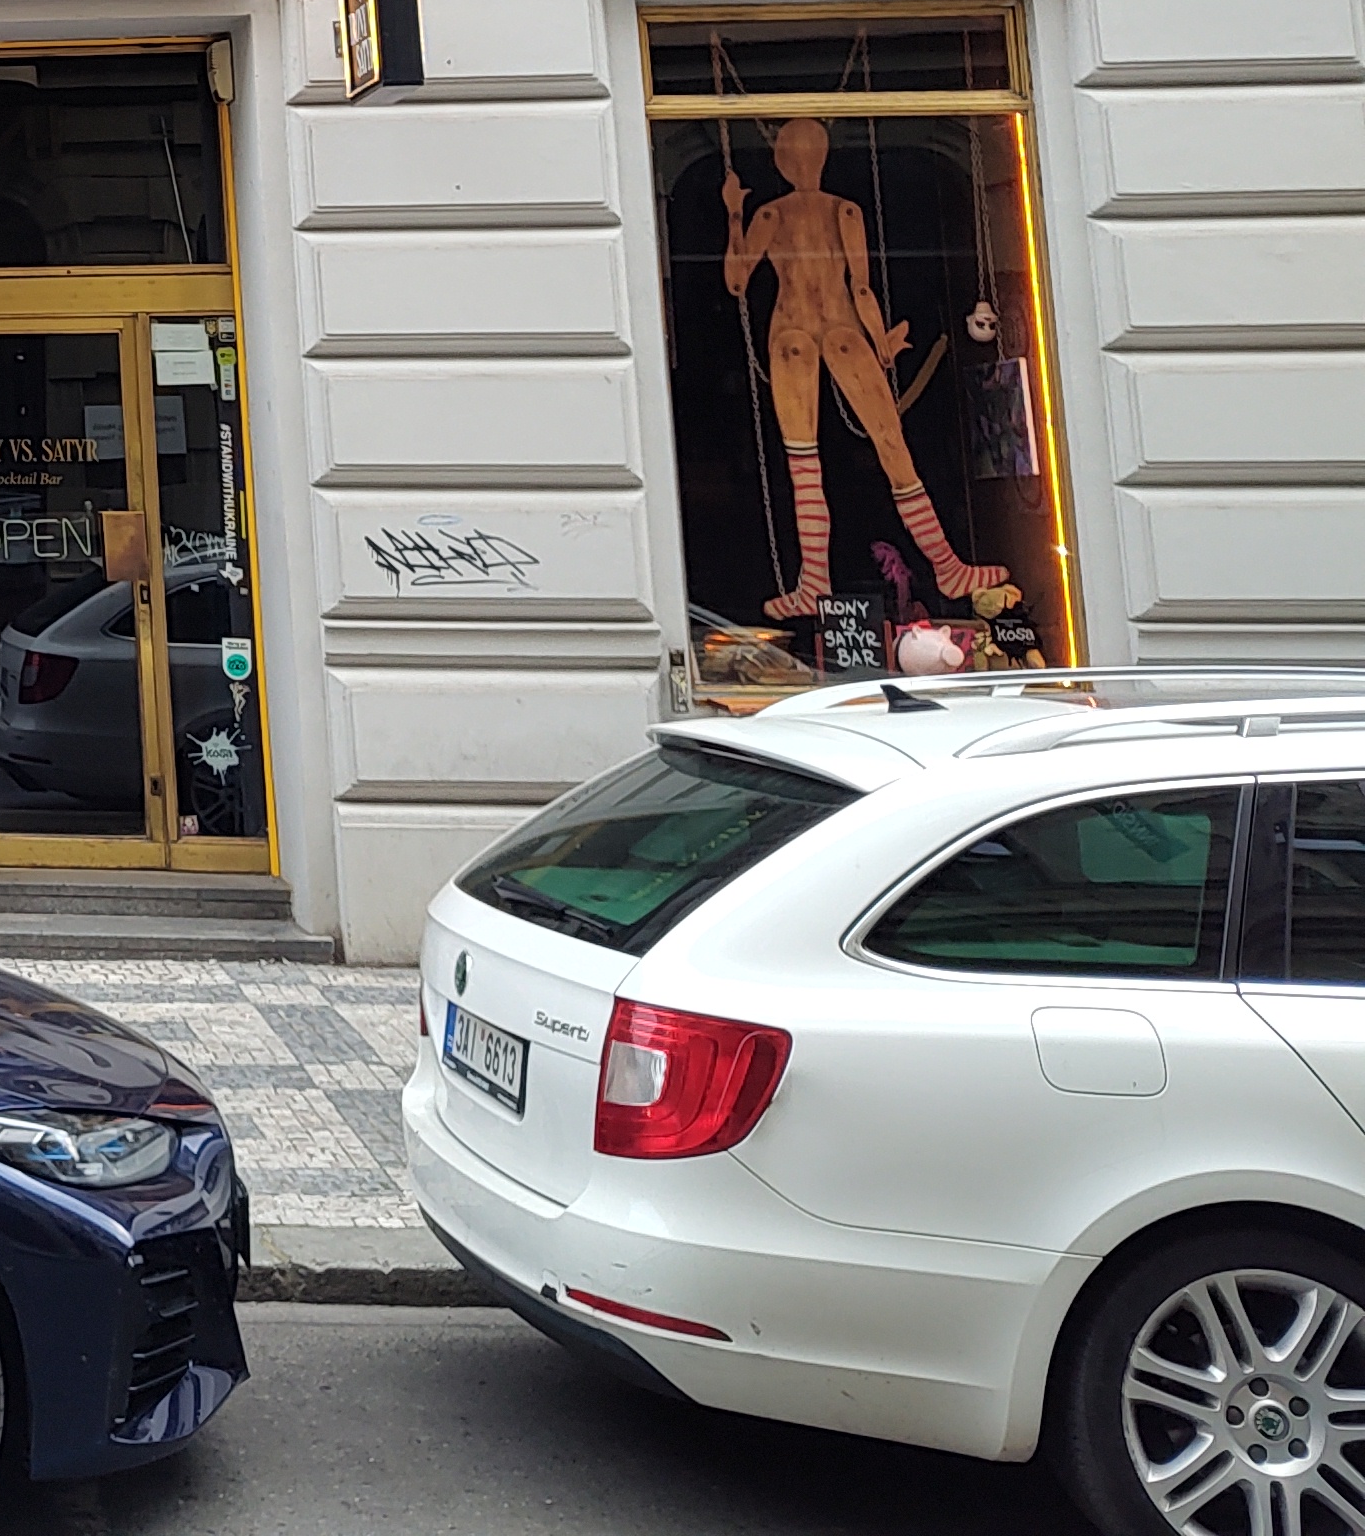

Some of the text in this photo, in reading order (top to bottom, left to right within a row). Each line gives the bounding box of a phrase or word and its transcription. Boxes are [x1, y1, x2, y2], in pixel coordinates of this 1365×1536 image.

[9, 439, 37, 462] VS.
[41, 439, 100, 463] SATYR
[40, 472, 63, 485] Bar
[220, 423, 238, 561] #STANDWITHUKRAINE
[819, 599, 870, 624] IRONY
[824, 629, 882, 649] SATYR
[836, 648, 882, 668] BAR
[484, 1031, 517, 1087] 6613
